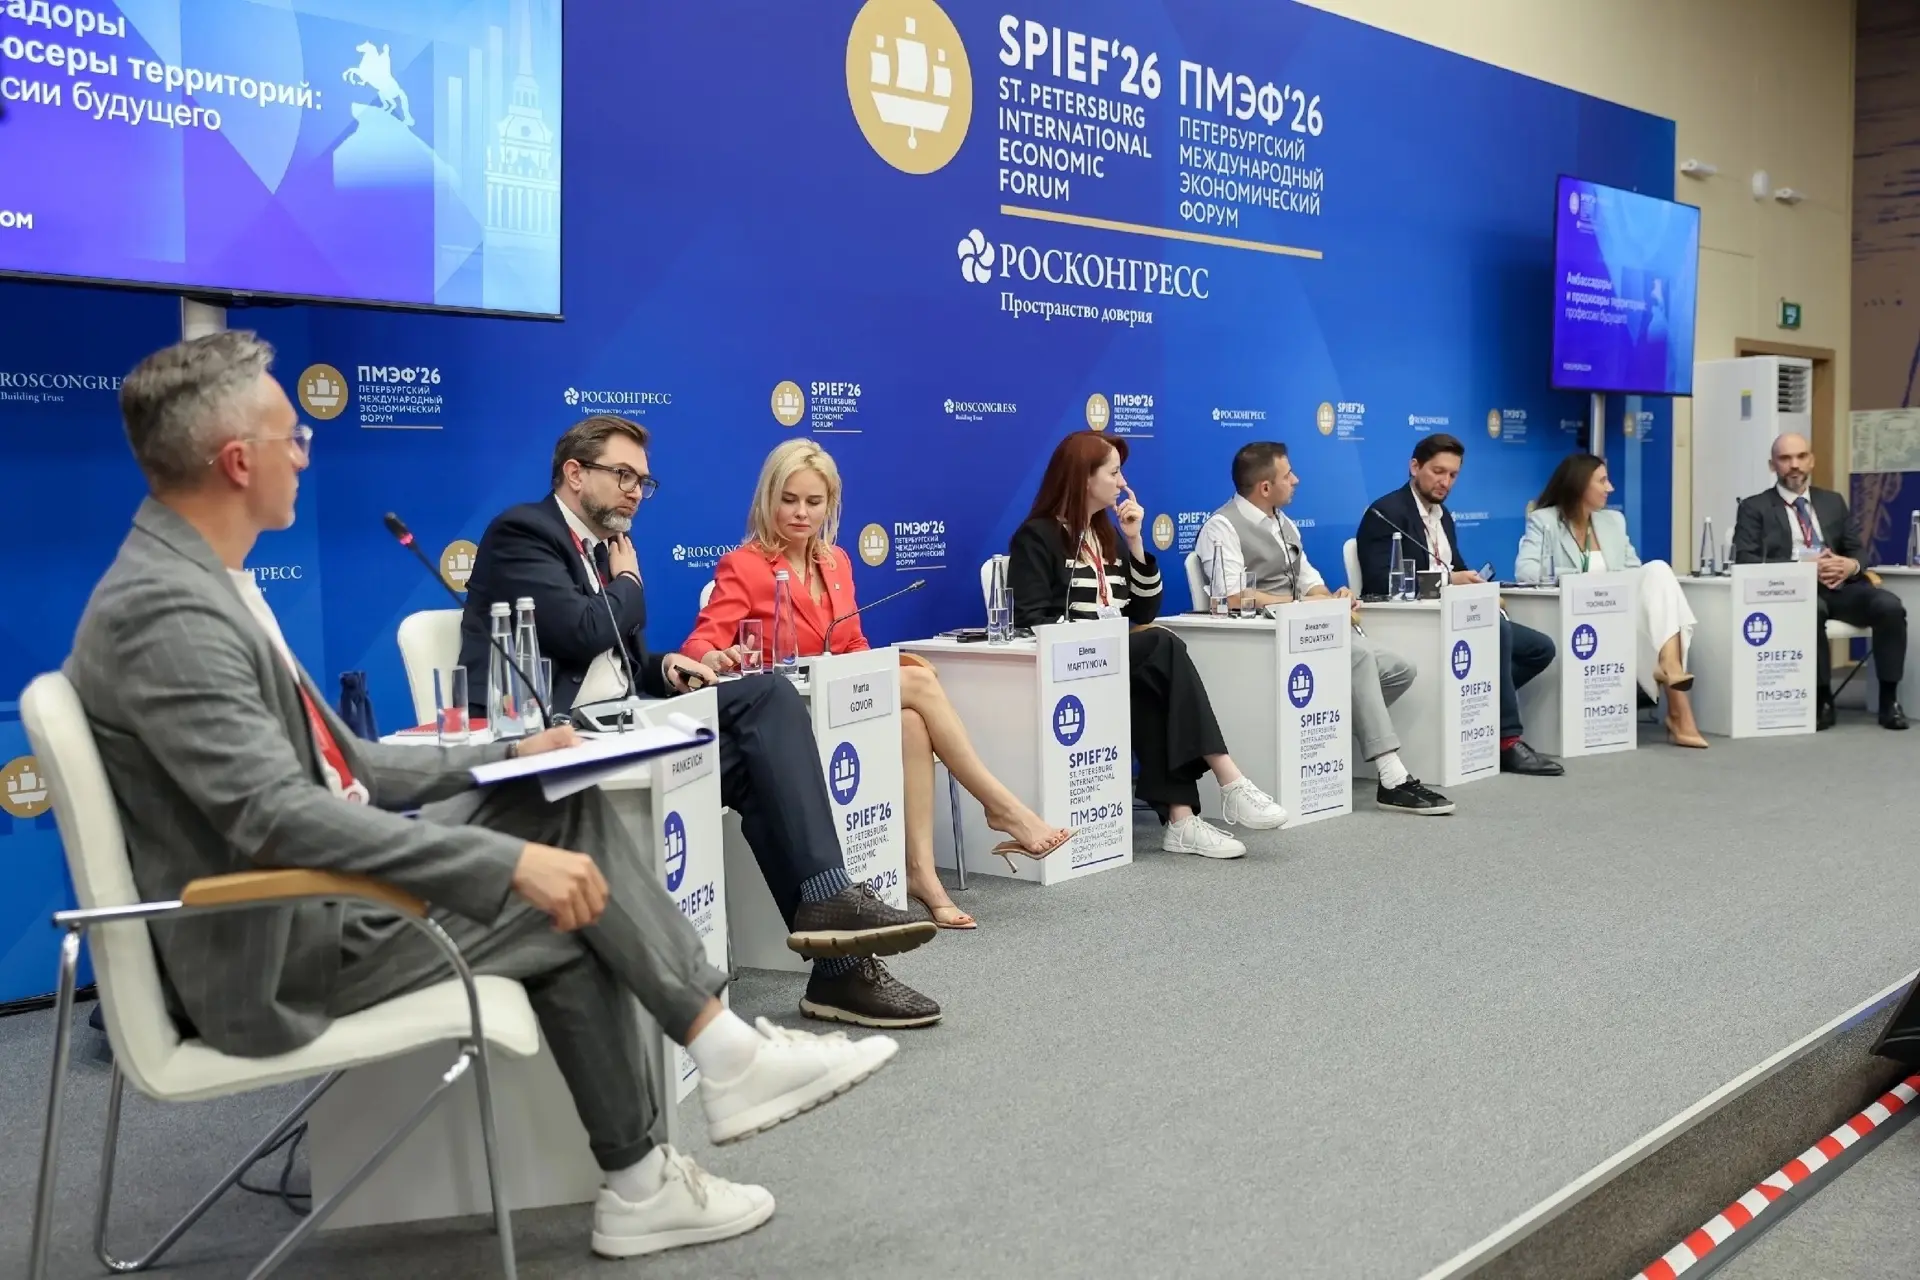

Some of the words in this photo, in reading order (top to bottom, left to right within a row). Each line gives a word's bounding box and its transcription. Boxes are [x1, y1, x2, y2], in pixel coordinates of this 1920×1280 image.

[0, 0, 125, 38] адоры
[999, 14, 1162, 100] SPIEF'26
[127, 57, 322, 110] территорий:
[0, 76, 61, 107] сии
[72, 81, 222, 131] будущего
[999, 76, 1026, 104] ST.
[1030, 83, 1145, 129] PETERSBURG
[1180, 59, 1323, 137] ПМЭФ'26
[999, 106, 1152, 159] INTERNATIONAL
[1180, 116, 1305, 162] ПЕТЕРБУРГСКИЙ
[999, 137, 1104, 178] ECONOMIC
[1180, 144, 1323, 191] МЕЖДУНАРОДНЫЙ
[999, 168, 1069, 201] FORUM
[1180, 172, 1320, 216] ЭКОНОМИЧЕСКИЙ
[1180, 200, 1238, 228] ФОРУМ
[1000, 243, 1209, 299] РОСКОНГРЕСС
[1000, 292, 1098, 321] Пространство
[1101, 308, 1153, 328] доверия
[0, 372, 123, 391] ROSCONGRE
[358, 366, 441, 384] ПМЭФ'26
[1, 391, 40, 404] Building
[42, 392, 64, 402] Trust
[358, 385, 431, 395] ПЕТЕРБУРГСКИЙ
[581, 391, 672, 405] РОСКОНГРЕСС
[811, 382, 861, 397] SPIEF'26
[359, 395, 443, 405] МЕЖДУНАРОДНЫЙ
[820, 398, 856, 406] PETERSBURG
[955, 401, 1017, 413] ROSCONGRESS
[1114, 394, 1154, 407] ПМЭФ'26
[360, 404, 441, 414] ЭКОНОМИЧЕСКИЙ
[360, 414, 393, 423] ФОРУМ
[894, 521, 945, 535] ПМЭФ'26
[895, 535, 939, 544] ПЕТЕРБУРГСКИЙ
[895, 542, 946, 551] МЕЖДУНАРОДНЫЙ
[896, 549, 945, 559] ЭКОНОМИЧЕСКИЙ
[1078, 647, 1096, 656] Elena
[1757, 650, 1803, 661] SPIEF'26
[1067, 659, 1107, 671] MARTYNOVA
[1584, 663, 1624, 676] SPIEF'26
[853, 683, 870, 694] Marta
[1461, 681, 1491, 697] SPIEF'26
[1757, 689, 1807, 702] ПМЭФ'26
[850, 698, 873, 712] GOVOR
[1584, 704, 1628, 718] ПМЭФ'26
[1300, 709, 1340, 728] SPIEF'26
[1461, 725, 1494, 742] ПМЭФ'26
[672, 752, 704, 776] PANKEVICH
[1069, 746, 1118, 768] SPIEF'26
[1078, 764, 1113, 777] PETERSBURG
[1301, 759, 1344, 779] ПМЭФ'26
[1070, 772, 1115, 788] INTERNATIONAL
[1070, 784, 1101, 797] ECONOMIC
[1070, 795, 1091, 805] FORUM
[846, 801, 892, 832] SPIEF'26
[1071, 802, 1123, 827] ПМЭФ'26
[854, 824, 888, 843] PETERSBURG
[847, 834, 889, 856] INTERNATIONAL
[847, 849, 876, 867] ECONOMIC
[676, 880, 715, 917] PIEF'26
